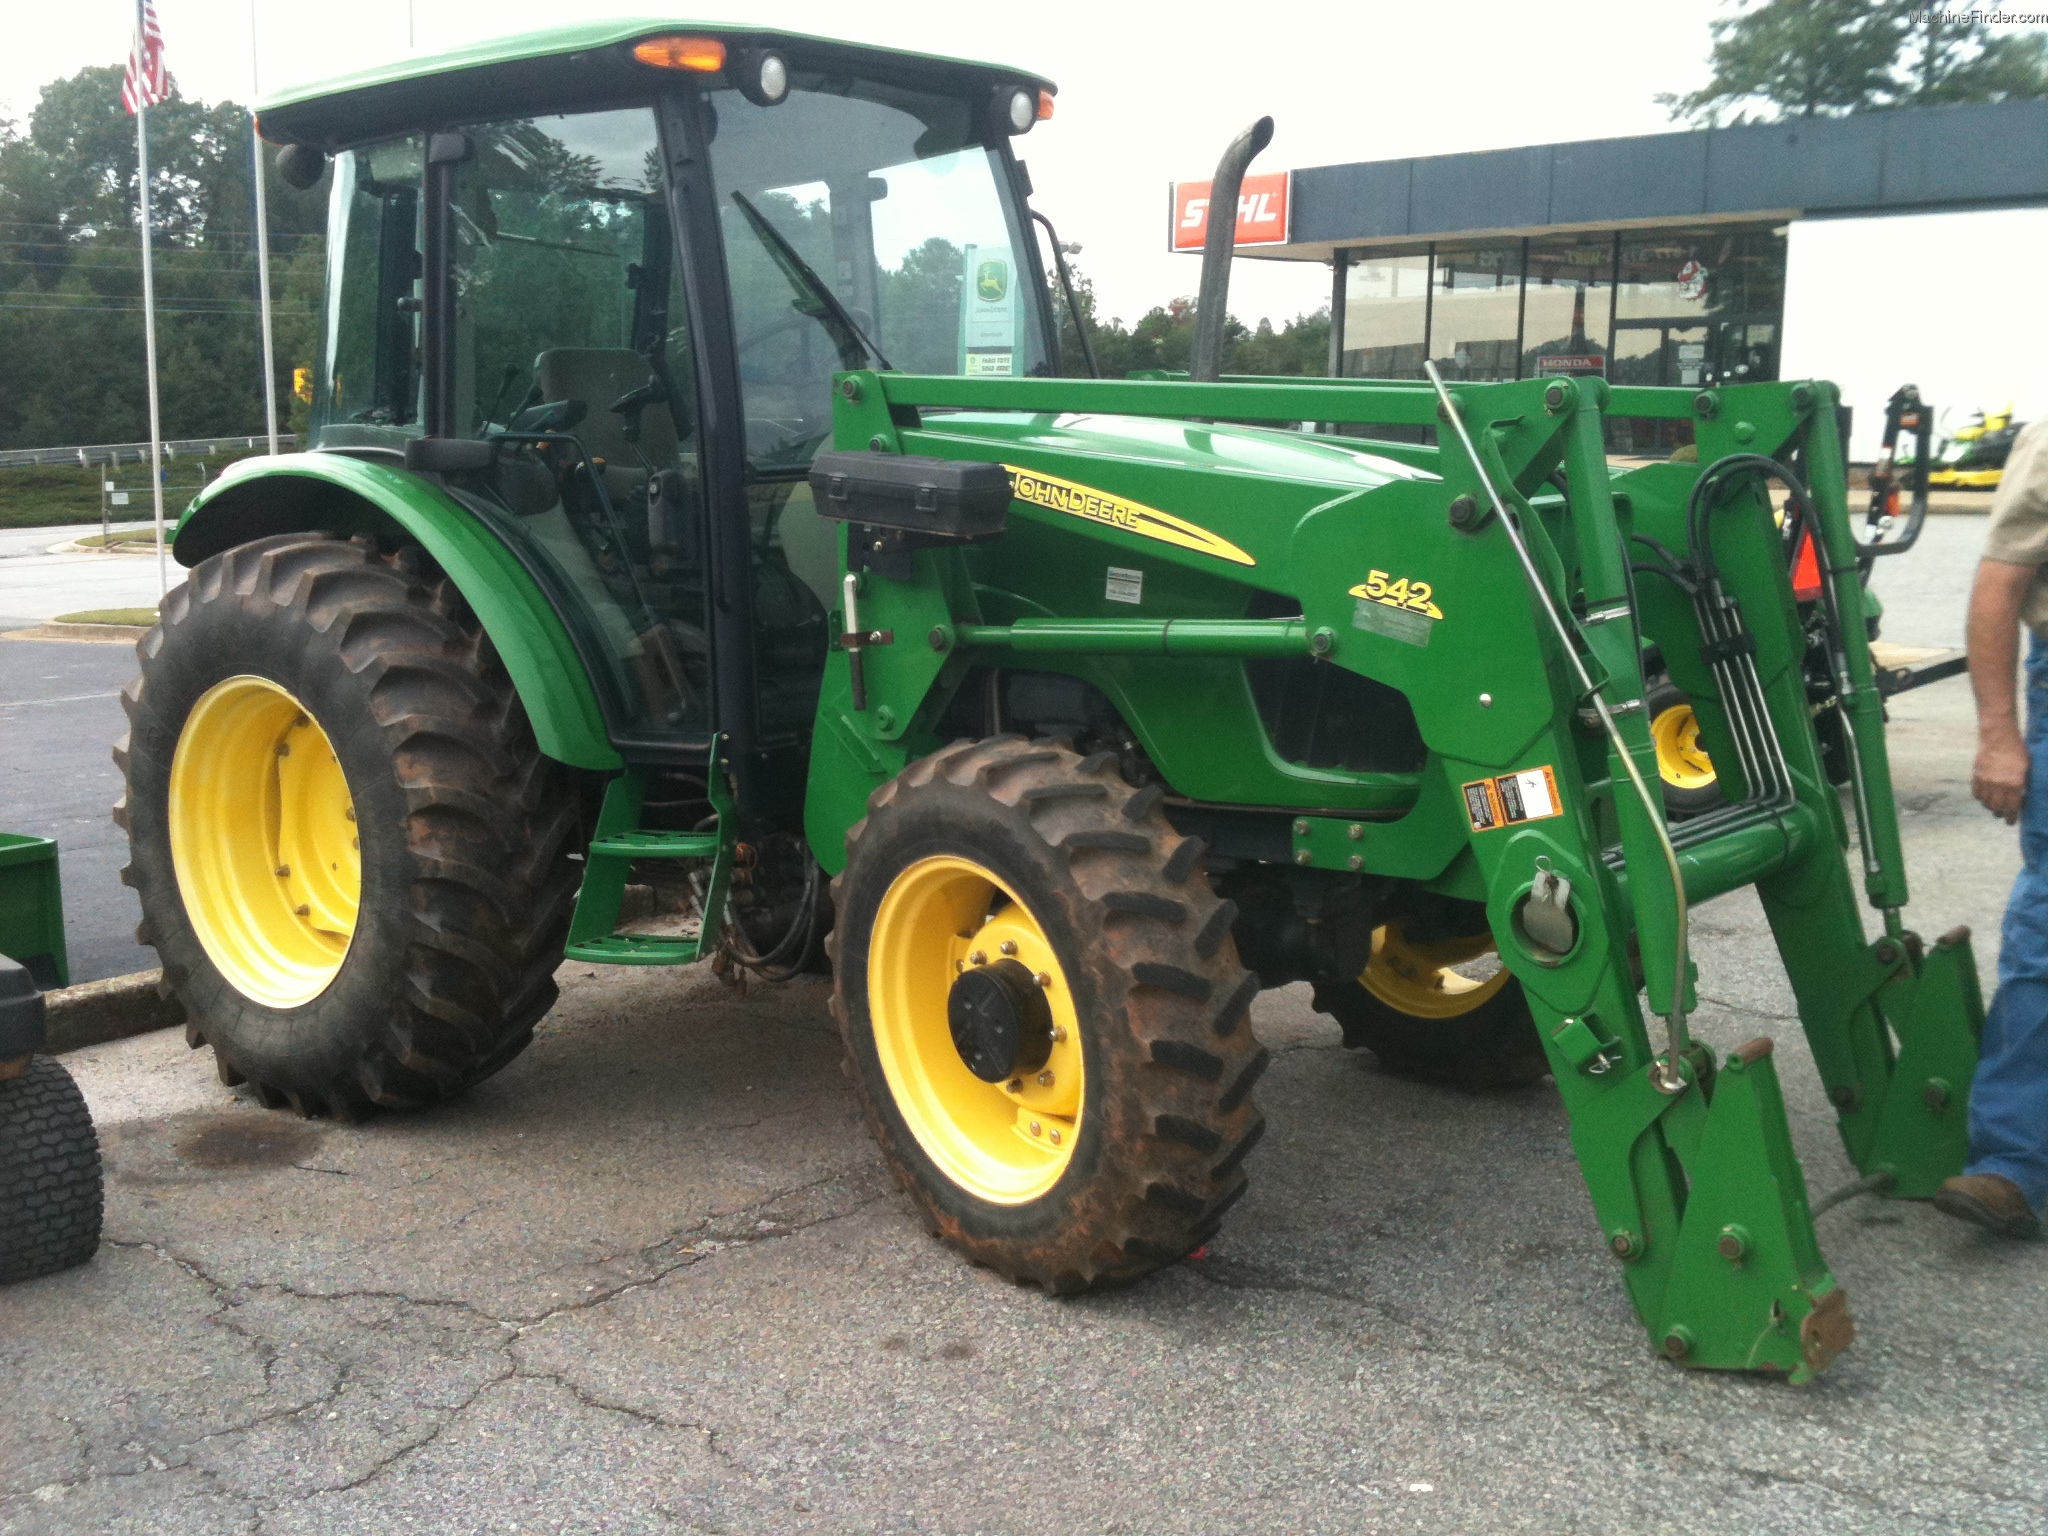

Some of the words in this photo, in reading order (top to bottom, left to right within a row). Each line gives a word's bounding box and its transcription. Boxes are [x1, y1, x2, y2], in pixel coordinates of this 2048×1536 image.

[1180, 193, 1277, 228] SHL
[1542, 358, 1592, 367] HONDA
[1009, 472, 1067, 508] JOHN
[1067, 487, 1140, 529] DEERE
[1365, 569, 1432, 613] 542
